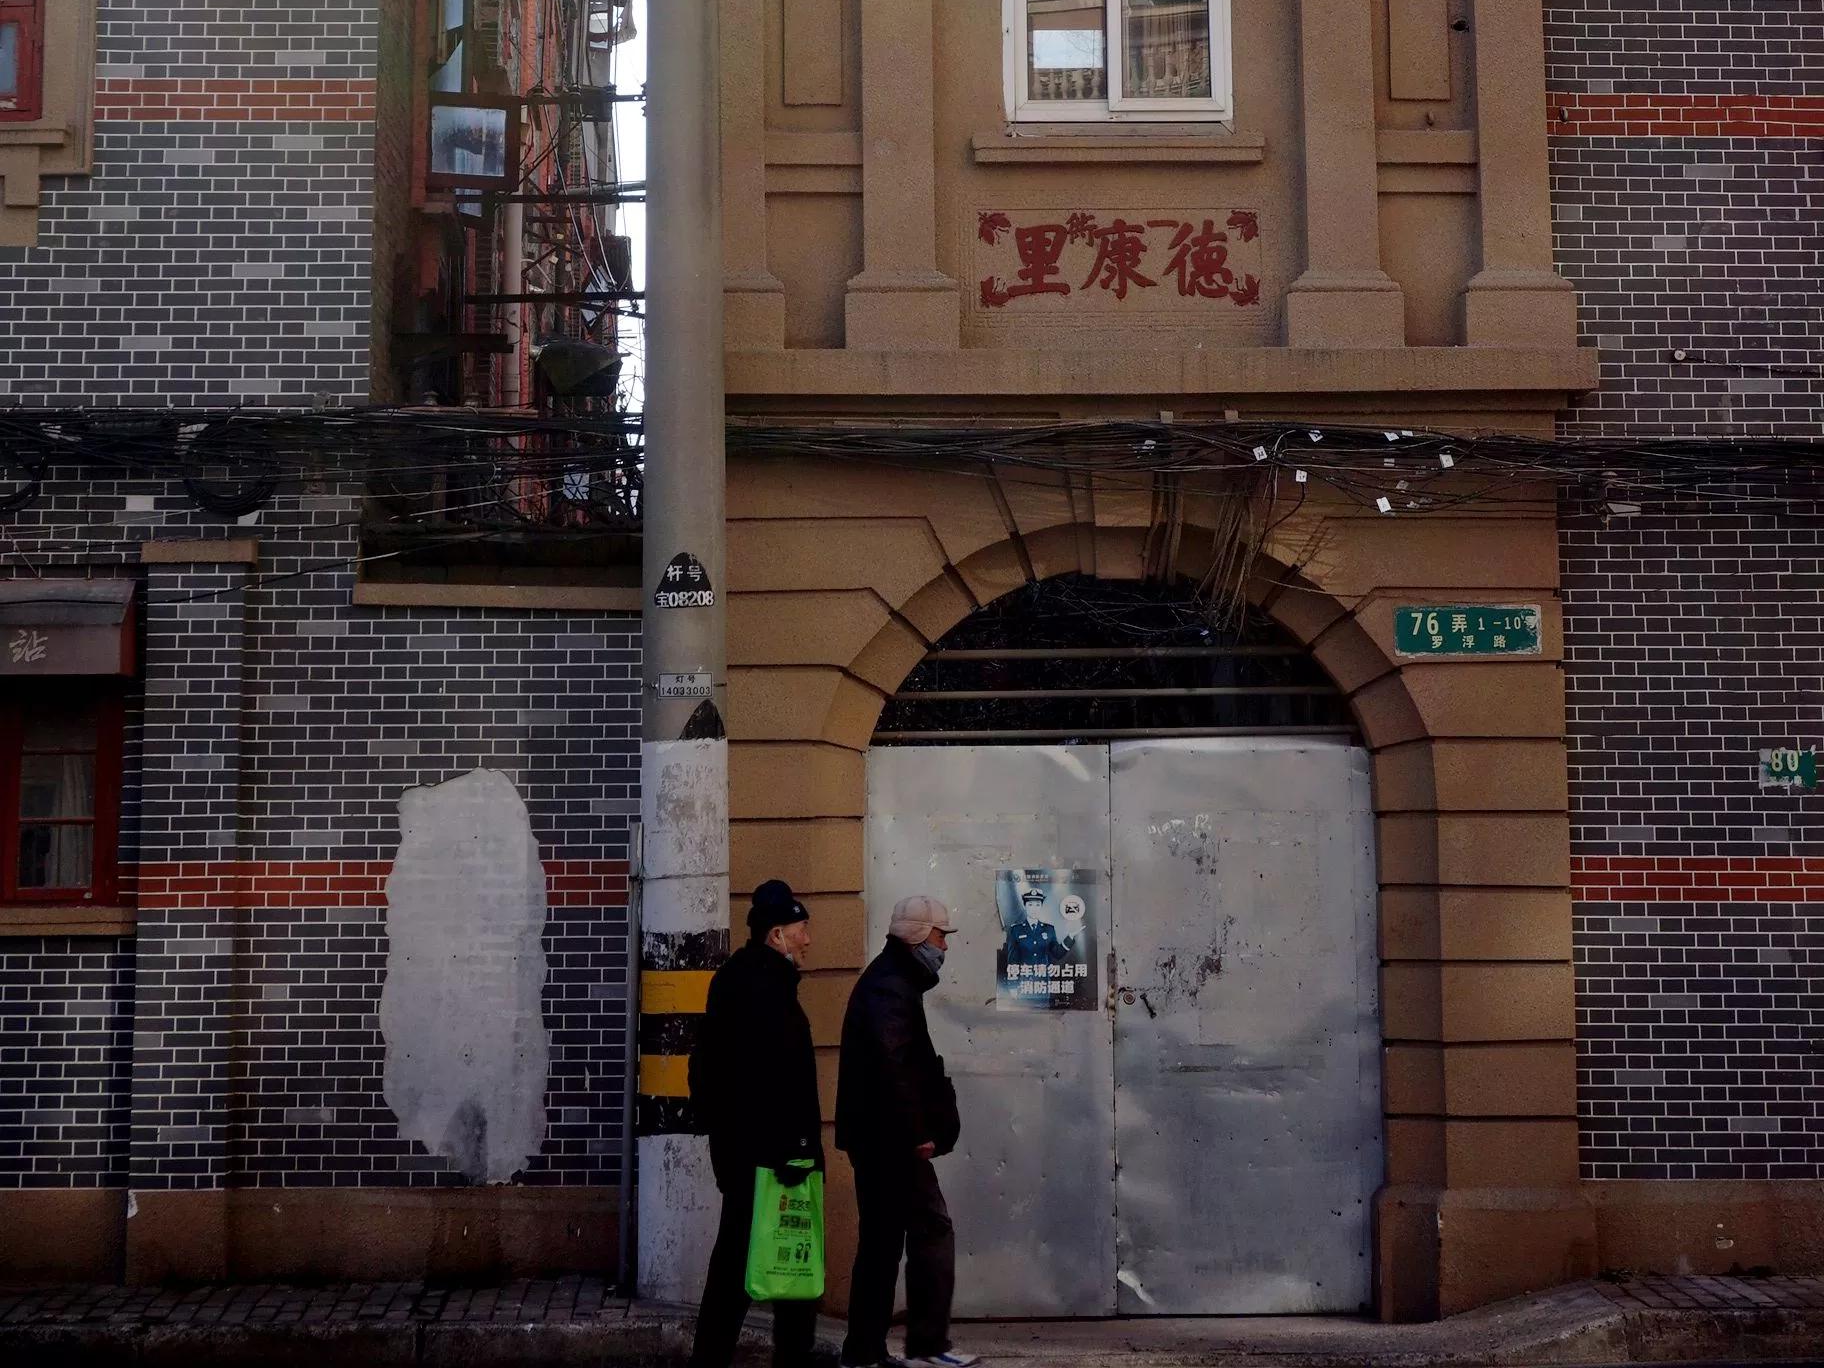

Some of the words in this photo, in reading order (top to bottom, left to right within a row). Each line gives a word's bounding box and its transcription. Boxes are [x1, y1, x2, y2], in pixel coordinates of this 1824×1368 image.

[667, 564, 702, 582] 杆号
[656, 591, 714, 608] 宝08208
[1432, 635, 1506, 648] 罗浮路
[676, 675, 696, 683] 灯号
[1771, 749, 1799, 772] 80
[1007, 964, 1088, 980] 停车请勿占用
[1020, 981, 1075, 994] 消防通道
